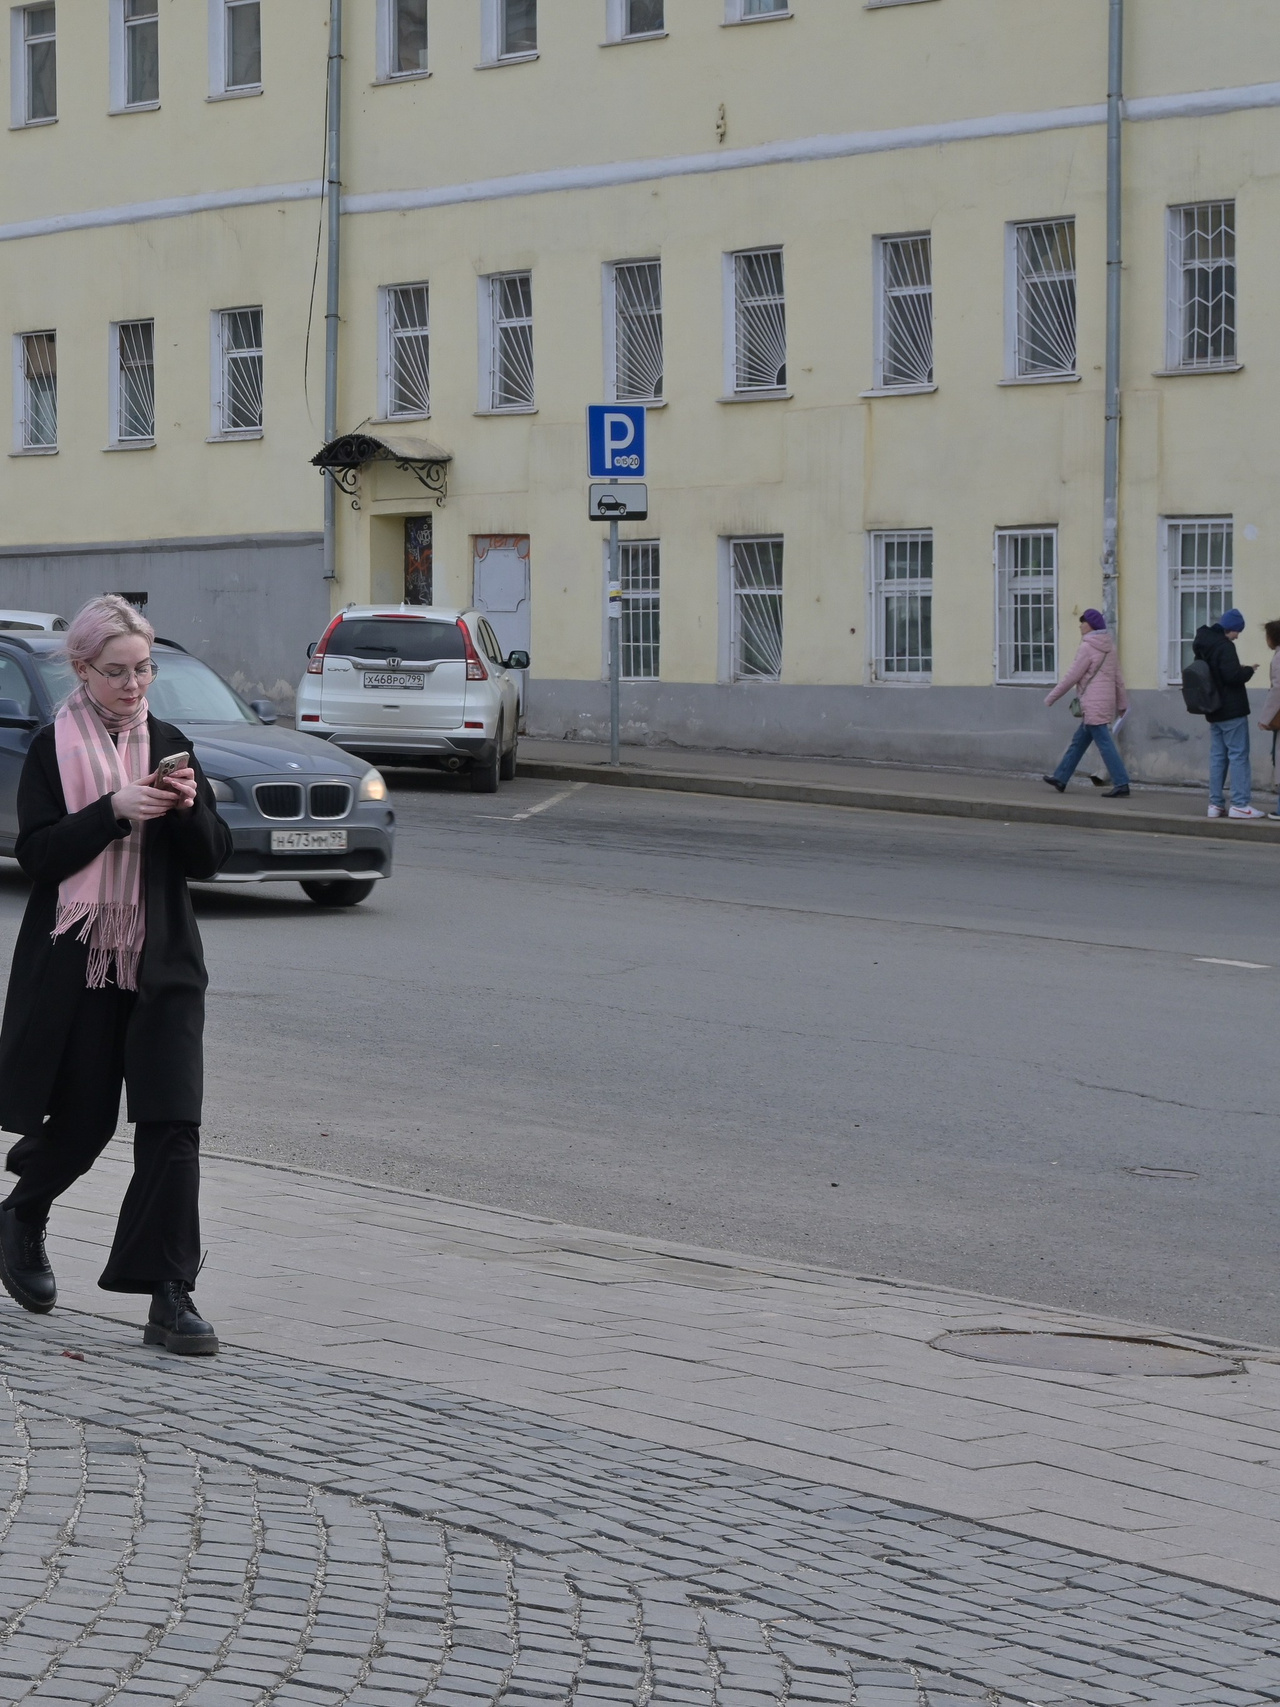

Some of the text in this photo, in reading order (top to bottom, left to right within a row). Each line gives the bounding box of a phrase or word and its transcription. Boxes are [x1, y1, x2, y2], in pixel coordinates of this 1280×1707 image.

[604, 413, 635, 469] P
[629, 457, 639, 466] 20
[368, 674, 423, 685] Х468РО 799
[331, 831, 344, 842] 99
